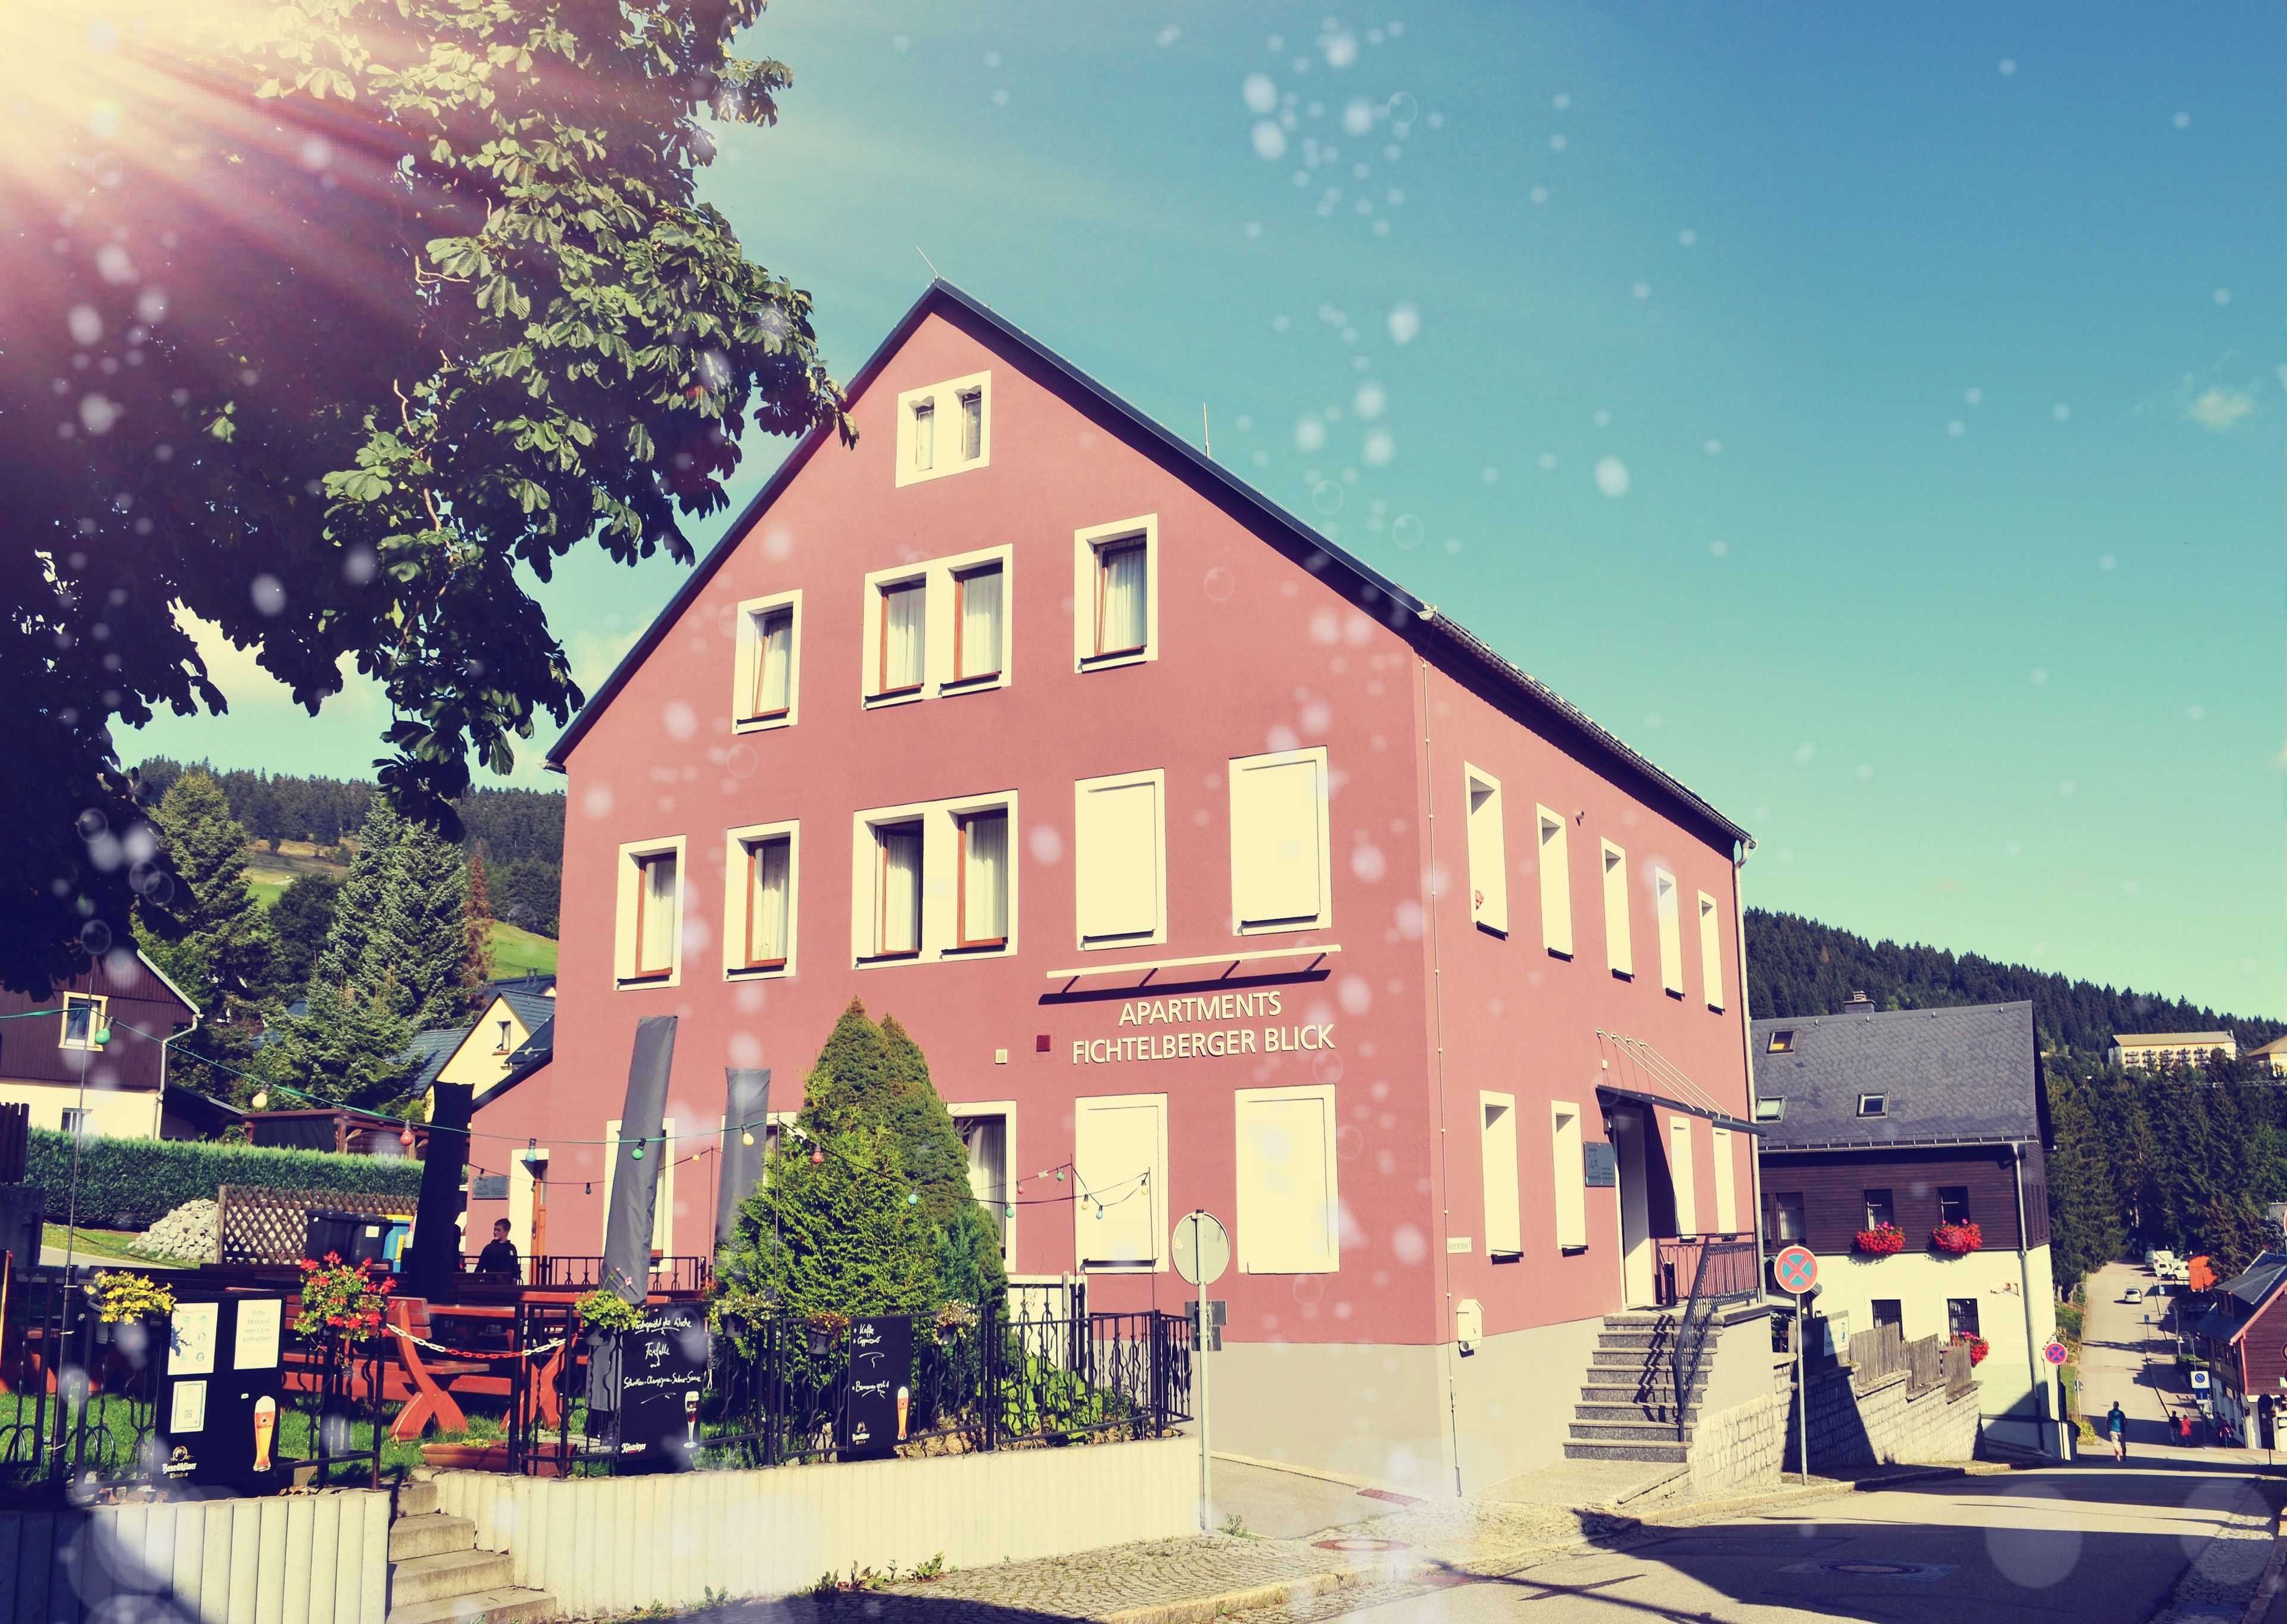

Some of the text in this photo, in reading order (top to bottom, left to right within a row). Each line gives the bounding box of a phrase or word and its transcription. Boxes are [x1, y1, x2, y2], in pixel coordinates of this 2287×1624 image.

[1118, 990, 1282, 1027] APARTMENTS
[1072, 1023, 1336, 1065] FICHTELBERGER BLICK
